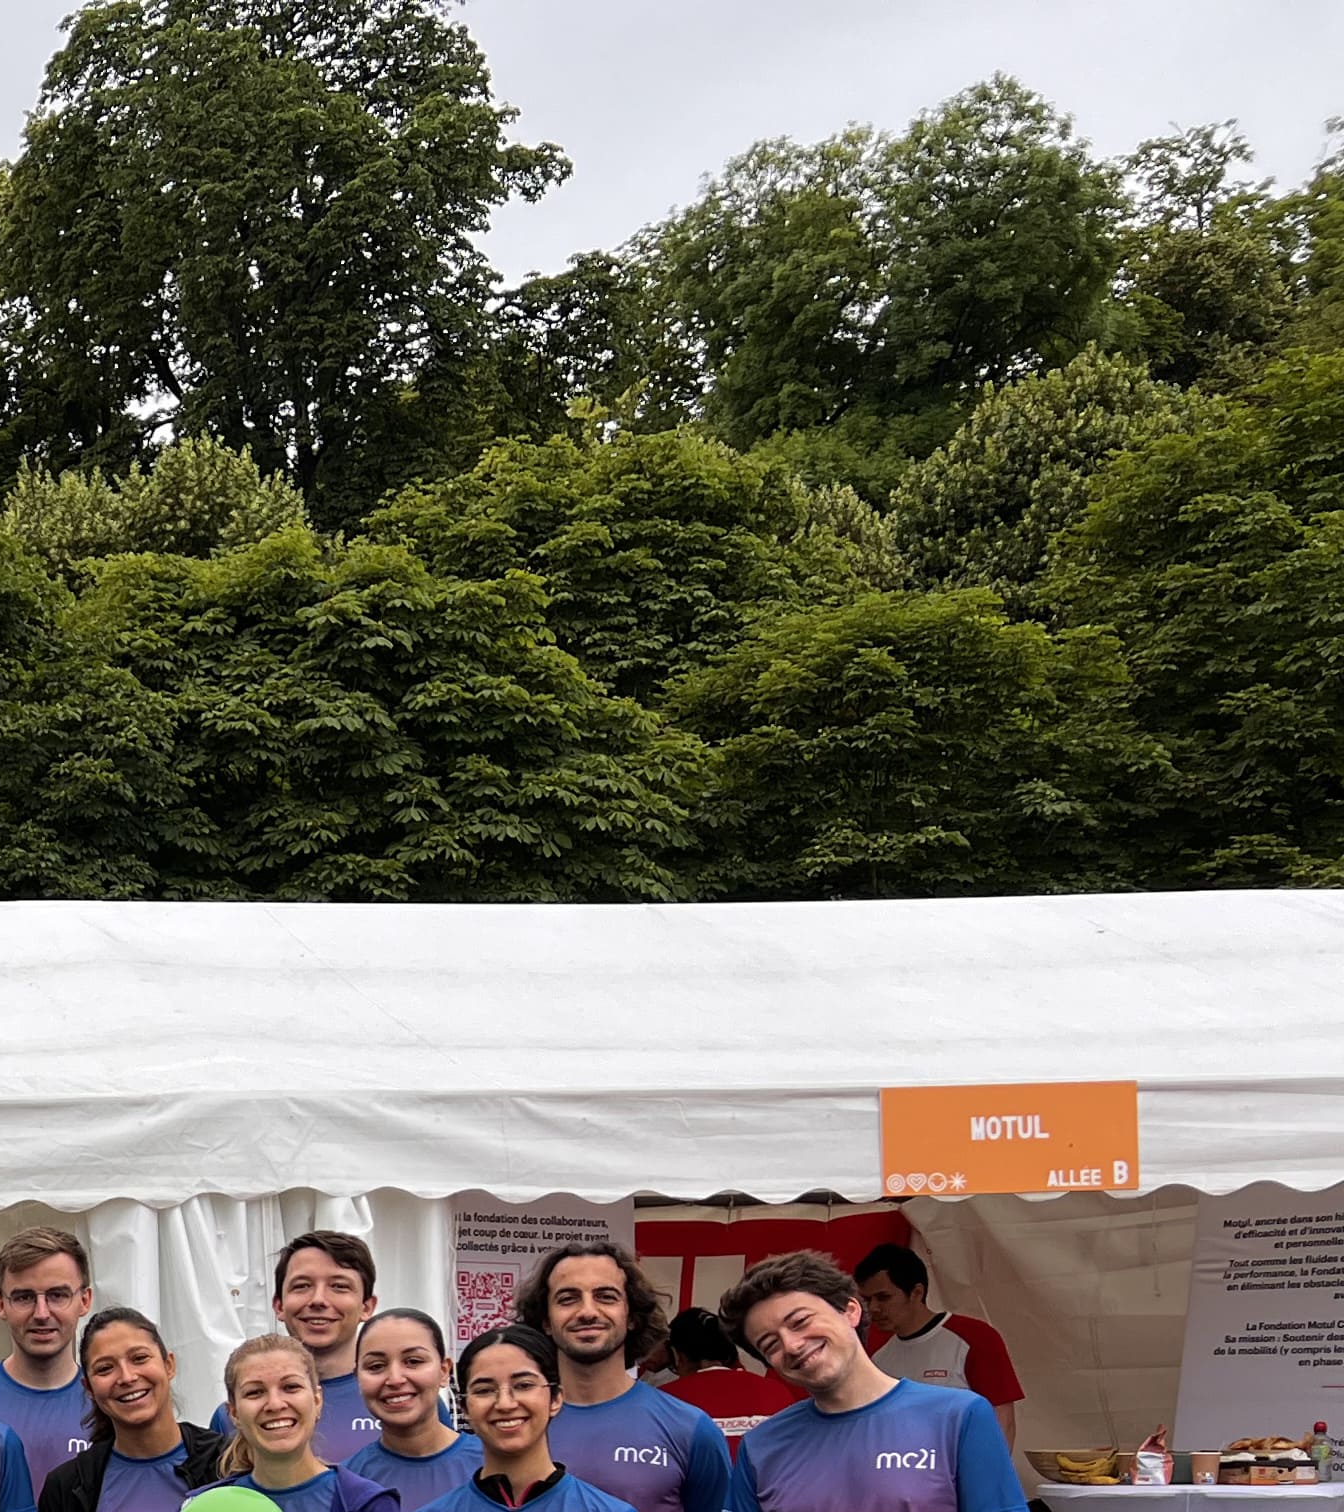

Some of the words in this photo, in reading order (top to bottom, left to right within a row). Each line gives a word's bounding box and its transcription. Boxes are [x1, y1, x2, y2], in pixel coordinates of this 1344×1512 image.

[970, 1115, 1049, 1141] MOTUL
[1113, 1160, 1128, 1184] B
[474, 1212, 519, 1224] fondation
[521, 1215, 538, 1225] des
[540, 1215, 608, 1228] collaborateurs,
[1255, 1216, 1288, 1226] ancrée
[1290, 1215, 1313, 1224] dans
[1315, 1214, 1333, 1223] son
[1335, 1212, 1344, 1221] hi
[473, 1229, 497, 1239] coup
[499, 1228, 510, 1238] de
[543, 1230, 553, 1240] Le
[555, 1231, 583, 1242] projet
[1288, 1228, 1298, 1236] et
[501, 1243, 528, 1254] grâce
[1274, 1241, 1284, 1249] et
[1285, 1237, 1343, 1250] personnelle
[1229, 1259, 1249, 1268] Tout
[1251, 1258, 1287, 1267] comme
[1289, 1256, 1304, 1265] les
[1305, 1255, 1339, 1264] fluides
[1223, 1271, 1231, 1280] la
[1300, 1268, 1309, 1277] la
[1227, 1283, 1239, 1291] en
[1287, 1280, 1301, 1289] les
[1303, 1278, 1344, 1288] obstacle
[1246, 1323, 1257, 1331] La
[1258, 1321, 1306, 1331] Fondation
[1307, 1320, 1335, 1330] Motul
[1225, 1335, 1236, 1344] Sa
[1238, 1333, 1276, 1343] mission
[1283, 1333, 1325, 1342] Soutenir
[1214, 1346, 1226, 1355] de
[1228, 1346, 1237, 1355] la
[1238, 1344, 1277, 1355] mobilité
[1291, 1344, 1331, 1355] compris
[1298, 1358, 1310, 1366] en
[1313, 1357, 1343, 1367] phase
[352, 1418, 383, 1431] mc
[614, 1446, 667, 1466] mc2i
[877, 1449, 935, 1469] mc2i
